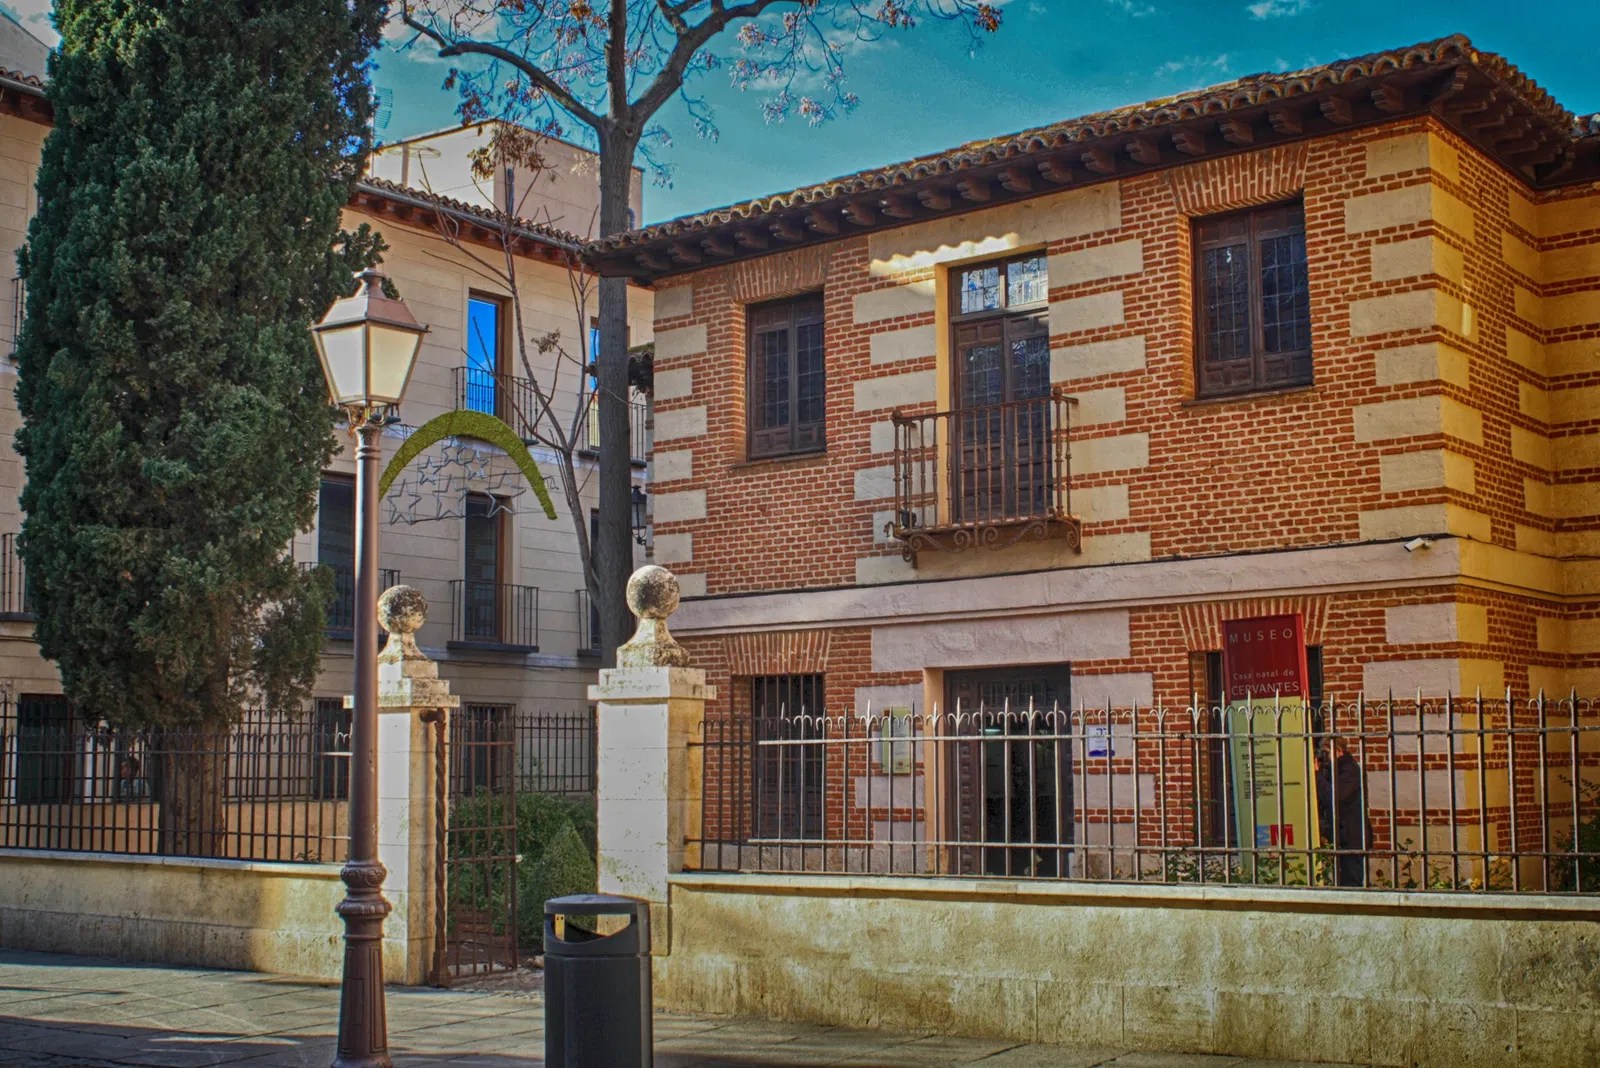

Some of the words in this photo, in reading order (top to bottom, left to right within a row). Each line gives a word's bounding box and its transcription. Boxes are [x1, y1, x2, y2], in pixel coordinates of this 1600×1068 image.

[1229, 628, 1293, 643] MUSEO
[1233, 672, 1253, 680] Casa
[1256, 669, 1279, 679] natal
[1282, 668, 1295, 677] de
[1231, 681, 1300, 696] CERVANTES
